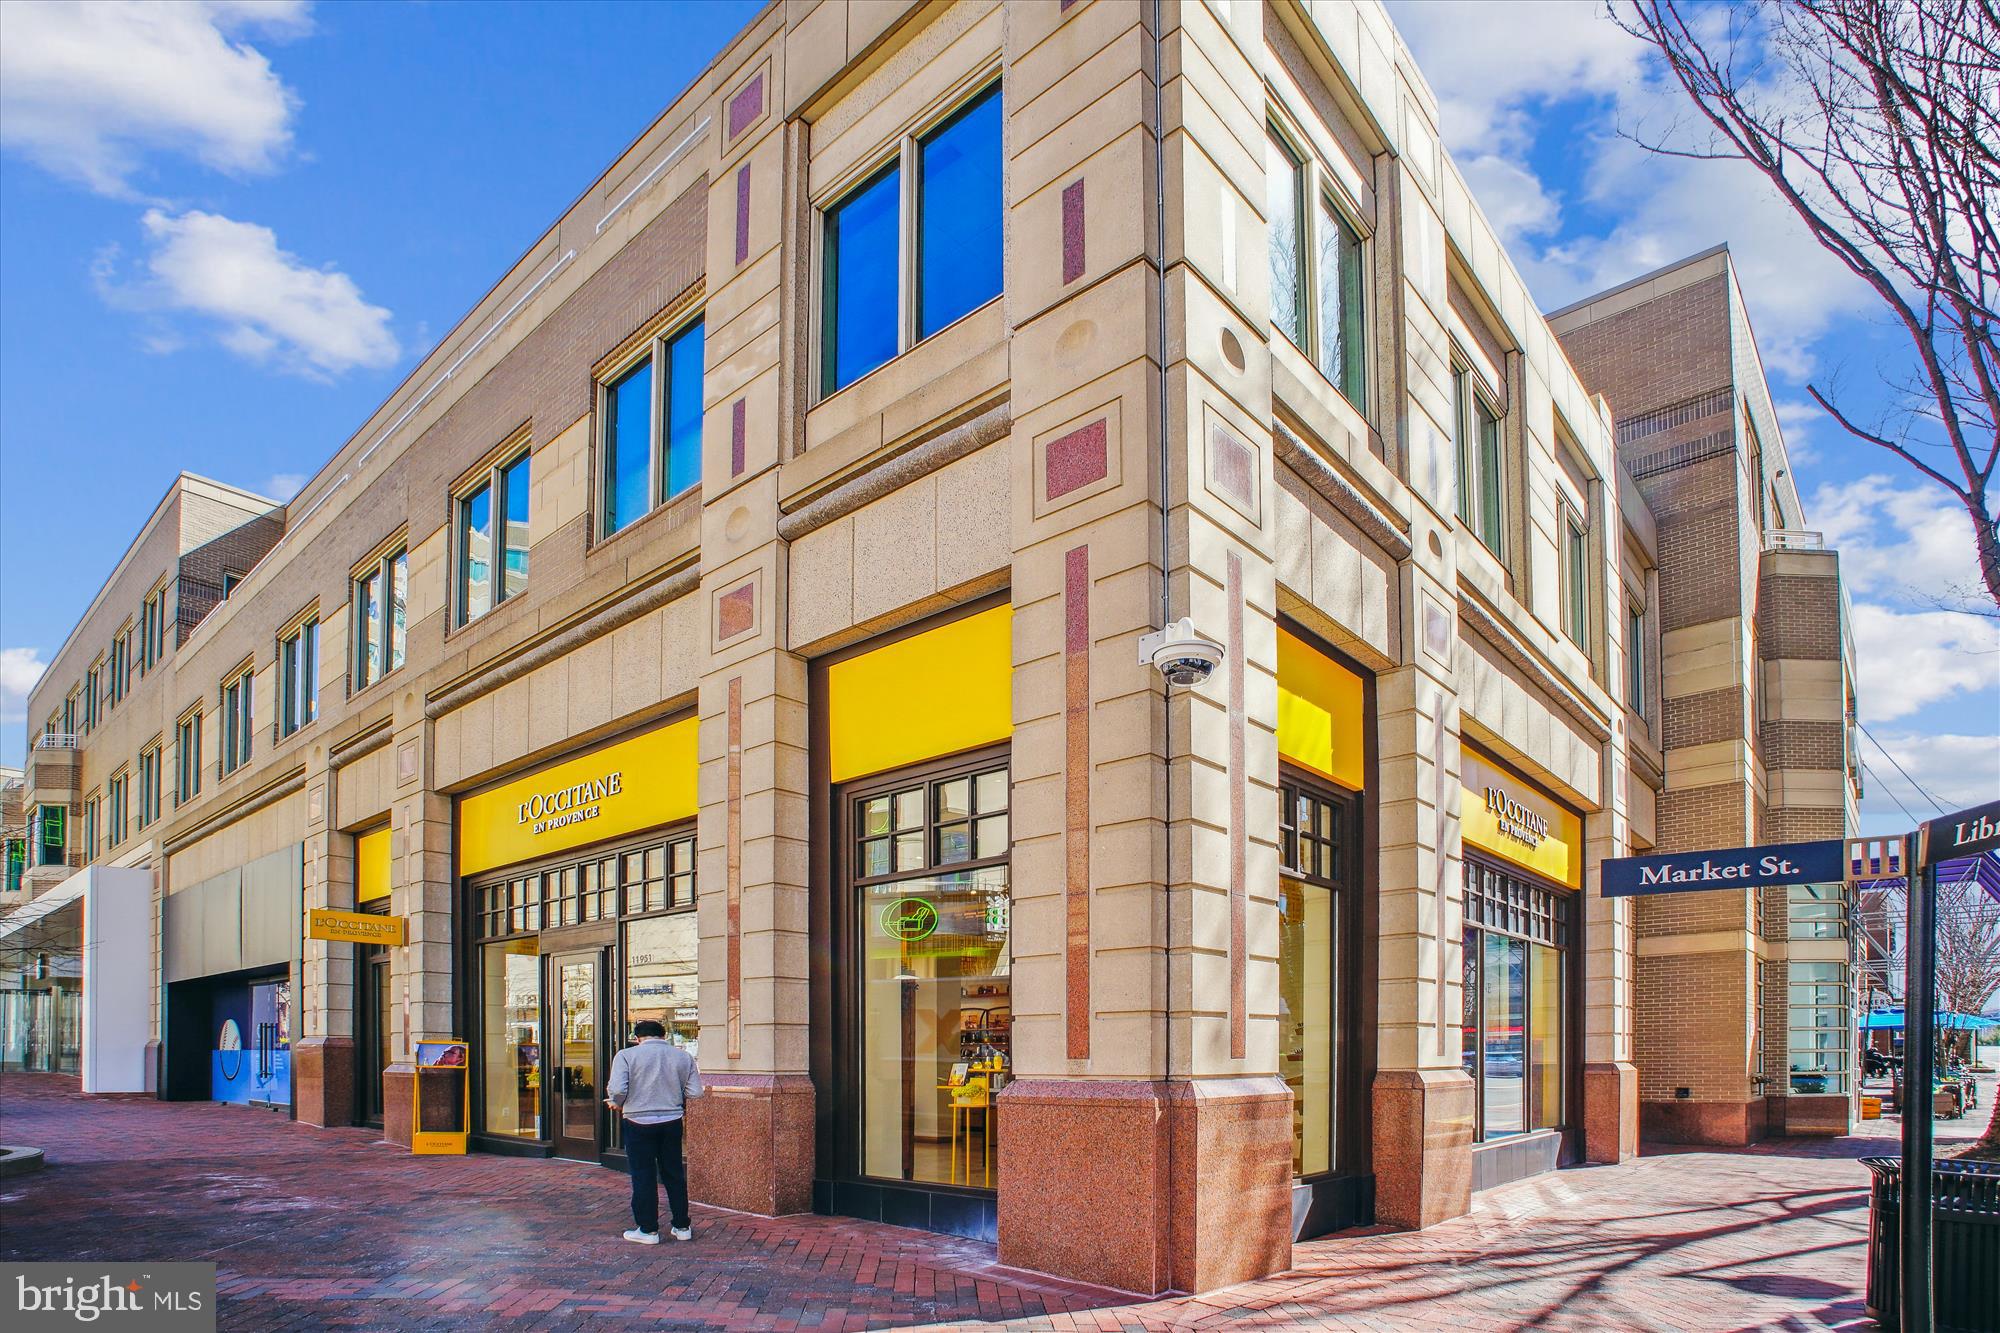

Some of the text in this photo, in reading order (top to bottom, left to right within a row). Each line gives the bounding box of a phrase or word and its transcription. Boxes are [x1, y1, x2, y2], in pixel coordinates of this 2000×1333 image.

[518, 772, 621, 824] L'OCCITANE
[1487, 786, 1549, 838] L'OCCITANE
[533, 806, 600, 834] EN PROVENCE
[1639, 855, 1800, 885] Market St.
[315, 917, 397, 934] L'OCCITANE
[632, 954, 652, 964] 11951
